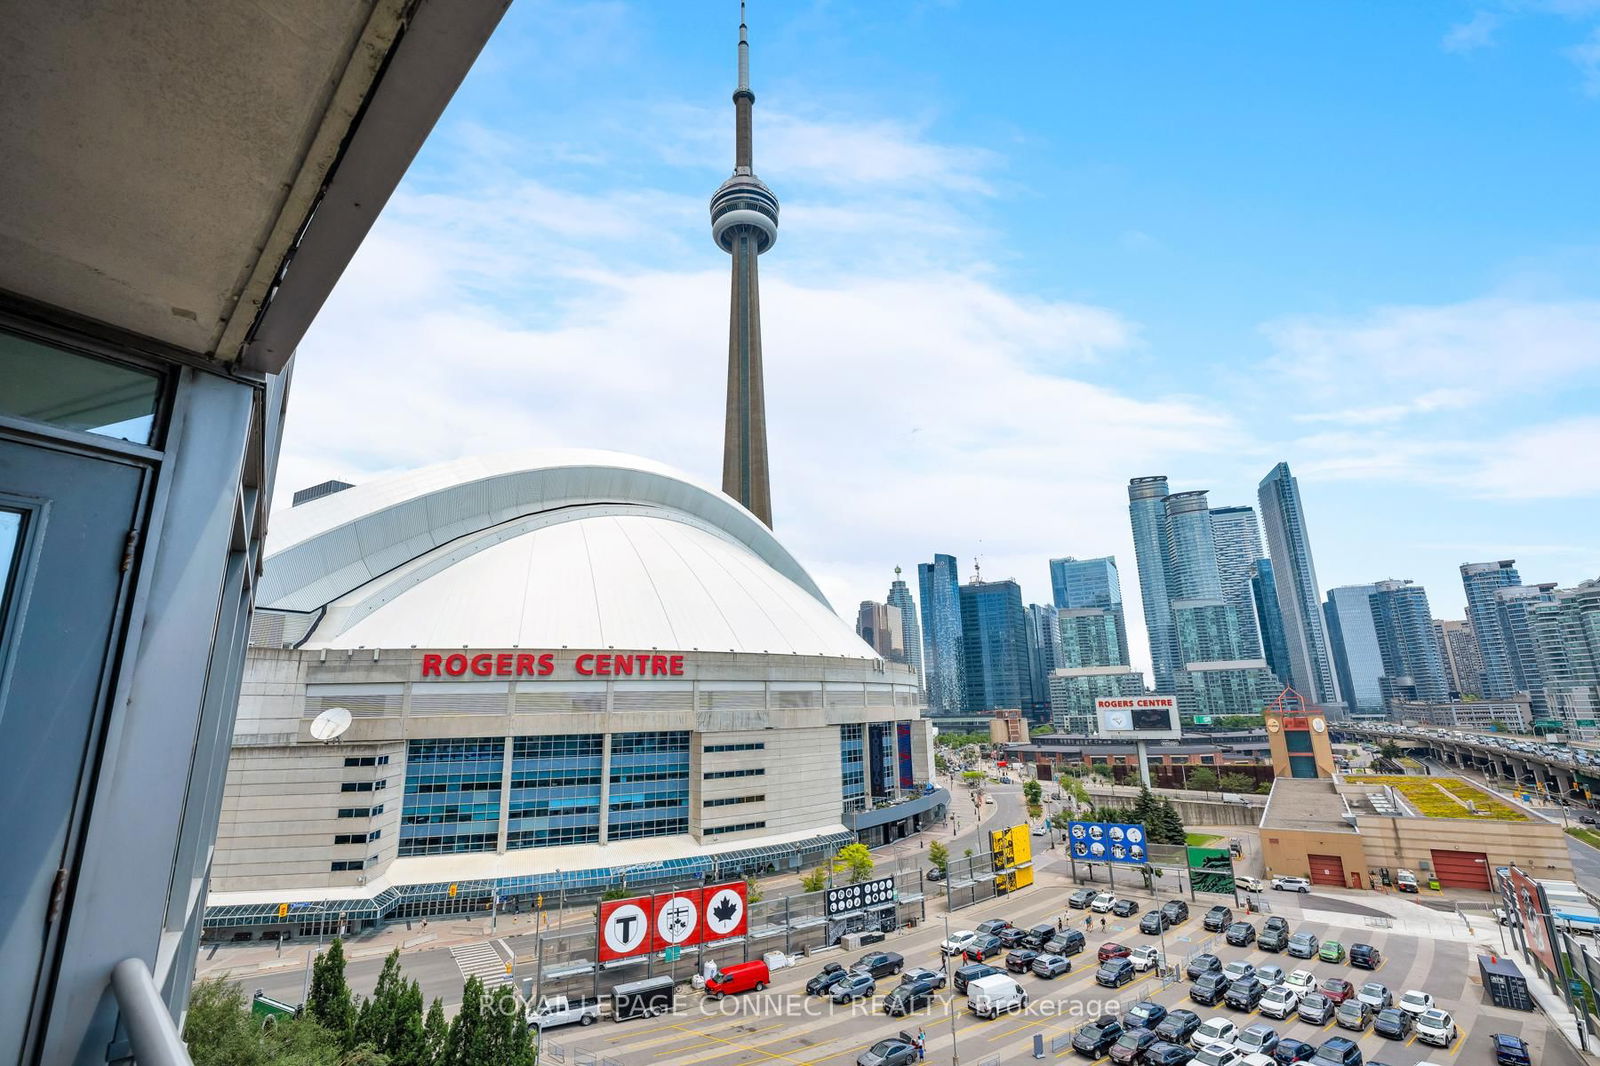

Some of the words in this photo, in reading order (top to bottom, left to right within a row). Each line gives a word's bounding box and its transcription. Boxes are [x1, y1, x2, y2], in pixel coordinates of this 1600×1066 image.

[422, 653, 554, 677] ROGERS
[575, 654, 684, 676] CENTRE
[1098, 700, 1134, 708] ROGERS
[1137, 699, 1173, 707] CENTRE
